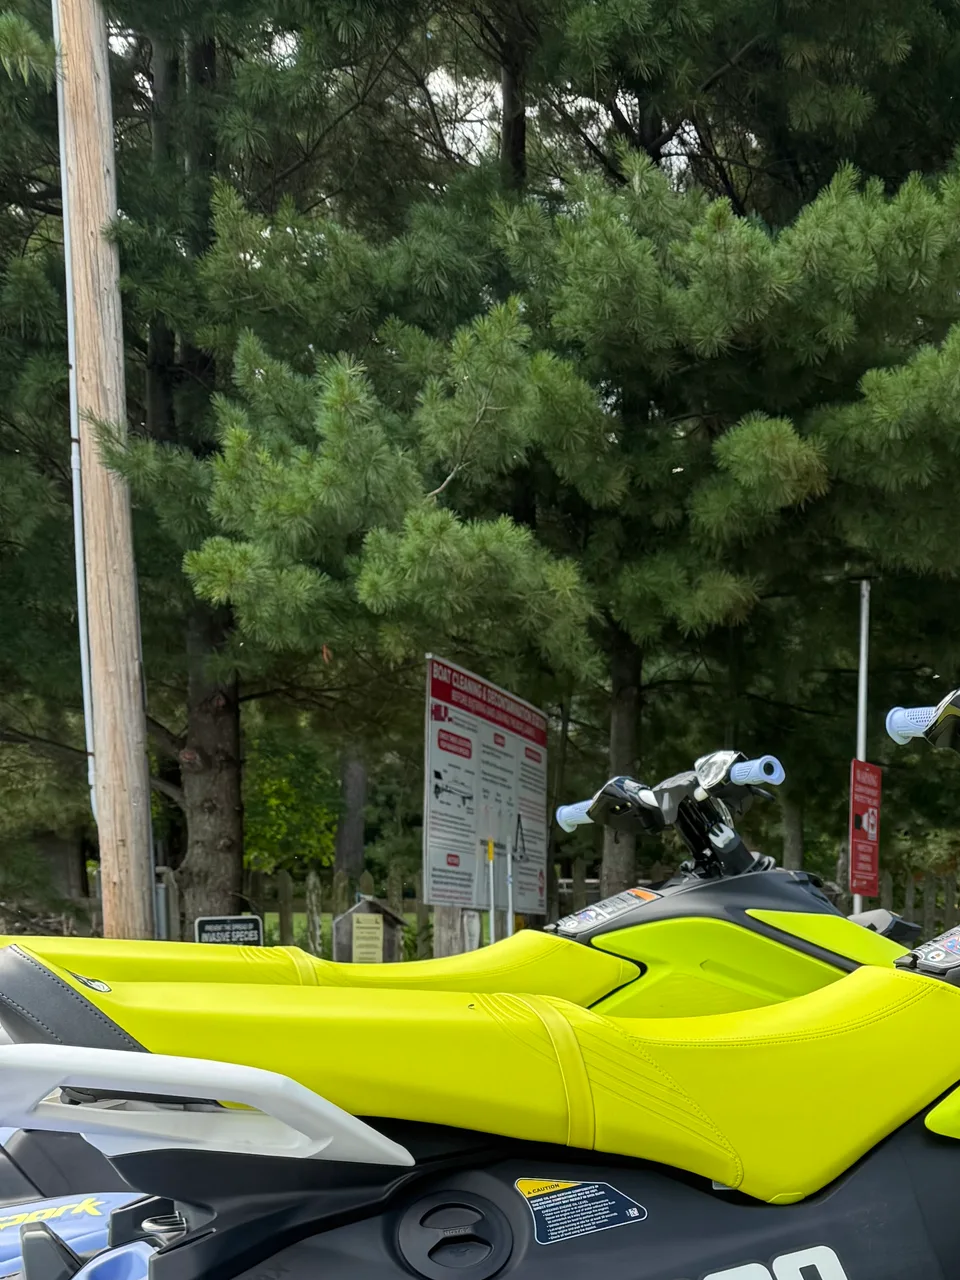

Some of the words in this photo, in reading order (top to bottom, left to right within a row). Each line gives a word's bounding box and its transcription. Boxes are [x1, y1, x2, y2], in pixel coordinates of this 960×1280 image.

[432, 662, 452, 684] BOAT
[452, 672, 483, 699] CLEANING
[201, 931, 230, 942] INVASIVE
[231, 930, 258, 941] SPECIES
[532, 1183, 560, 1194] CAUTION
[0, 1198, 106, 1230] park
